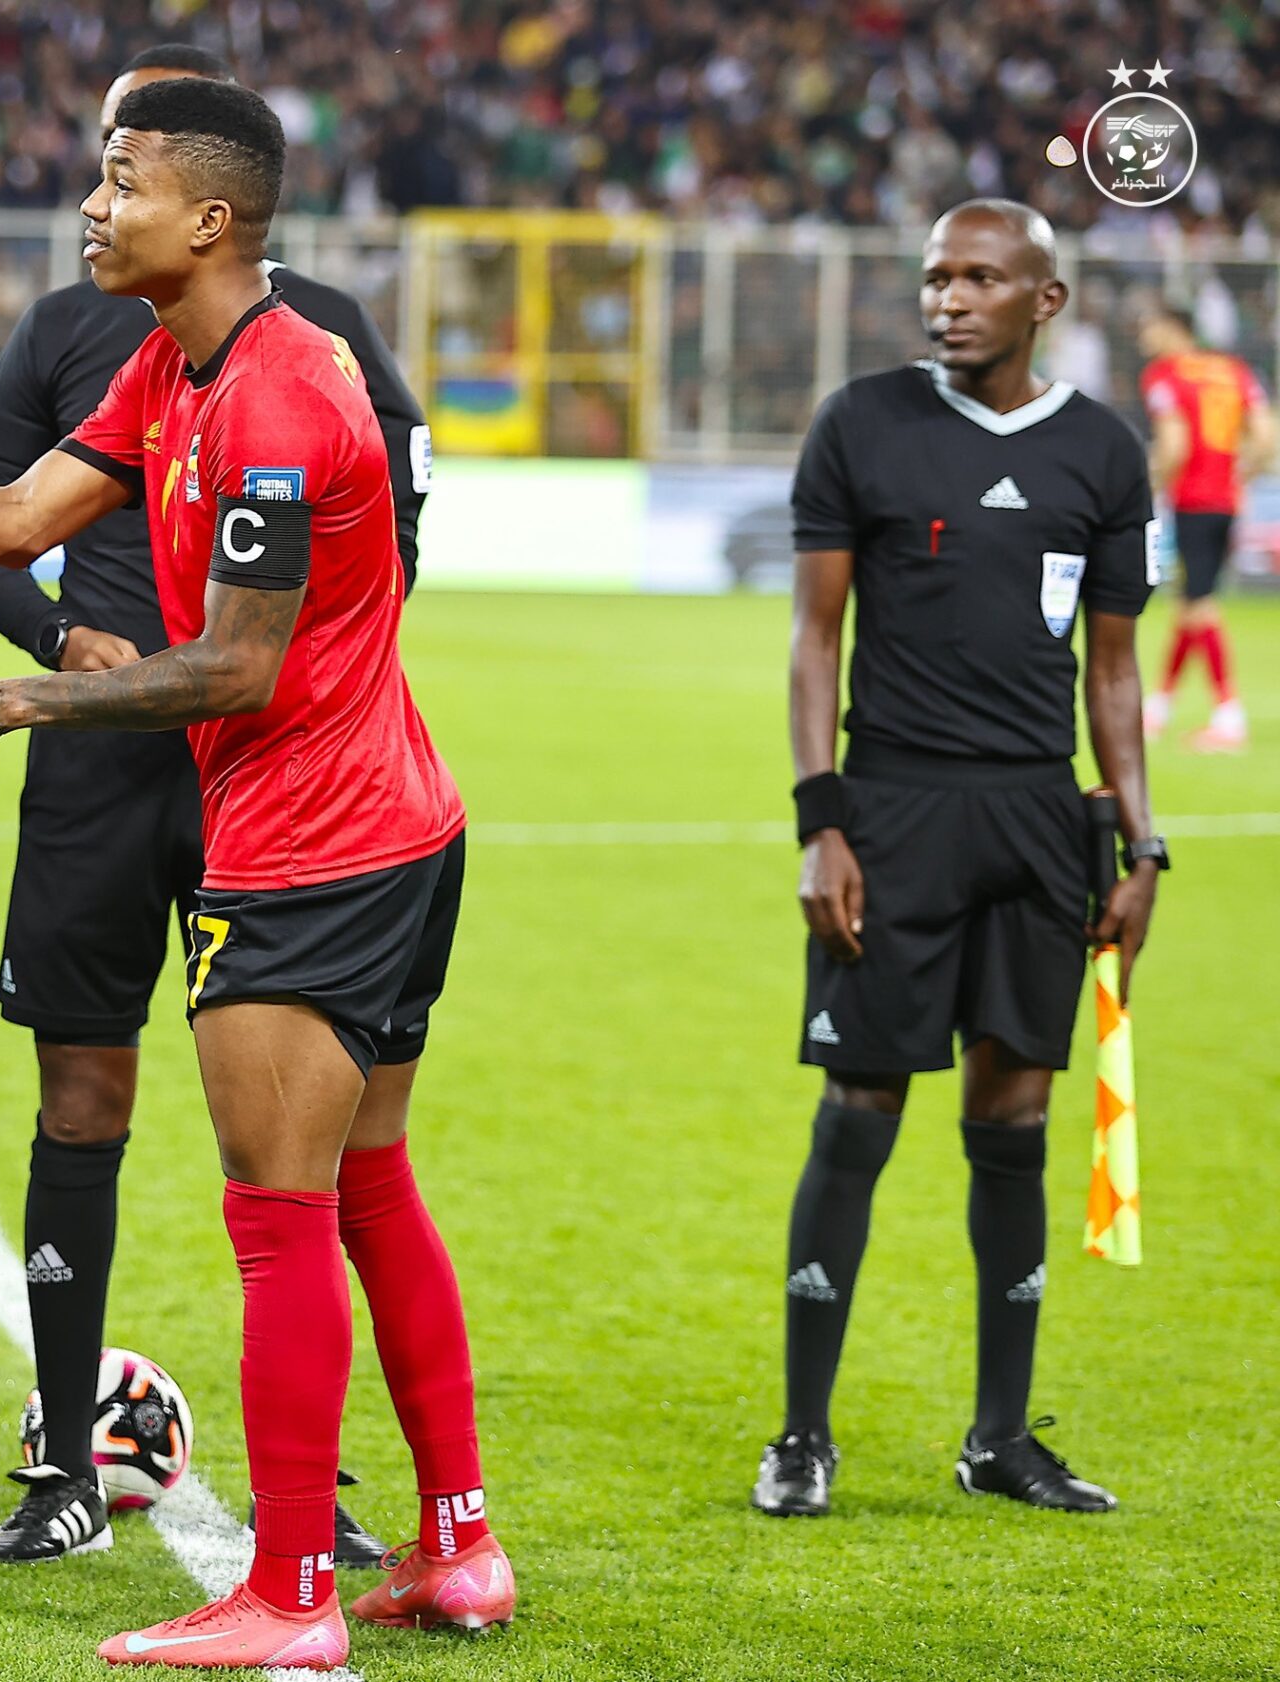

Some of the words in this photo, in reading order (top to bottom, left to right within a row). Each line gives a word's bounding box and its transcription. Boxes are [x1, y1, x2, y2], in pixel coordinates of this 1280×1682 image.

[256, 479, 293, 489] FOOTBALL
[256, 489, 293, 501] UNITES
[221, 507, 266, 564] C
